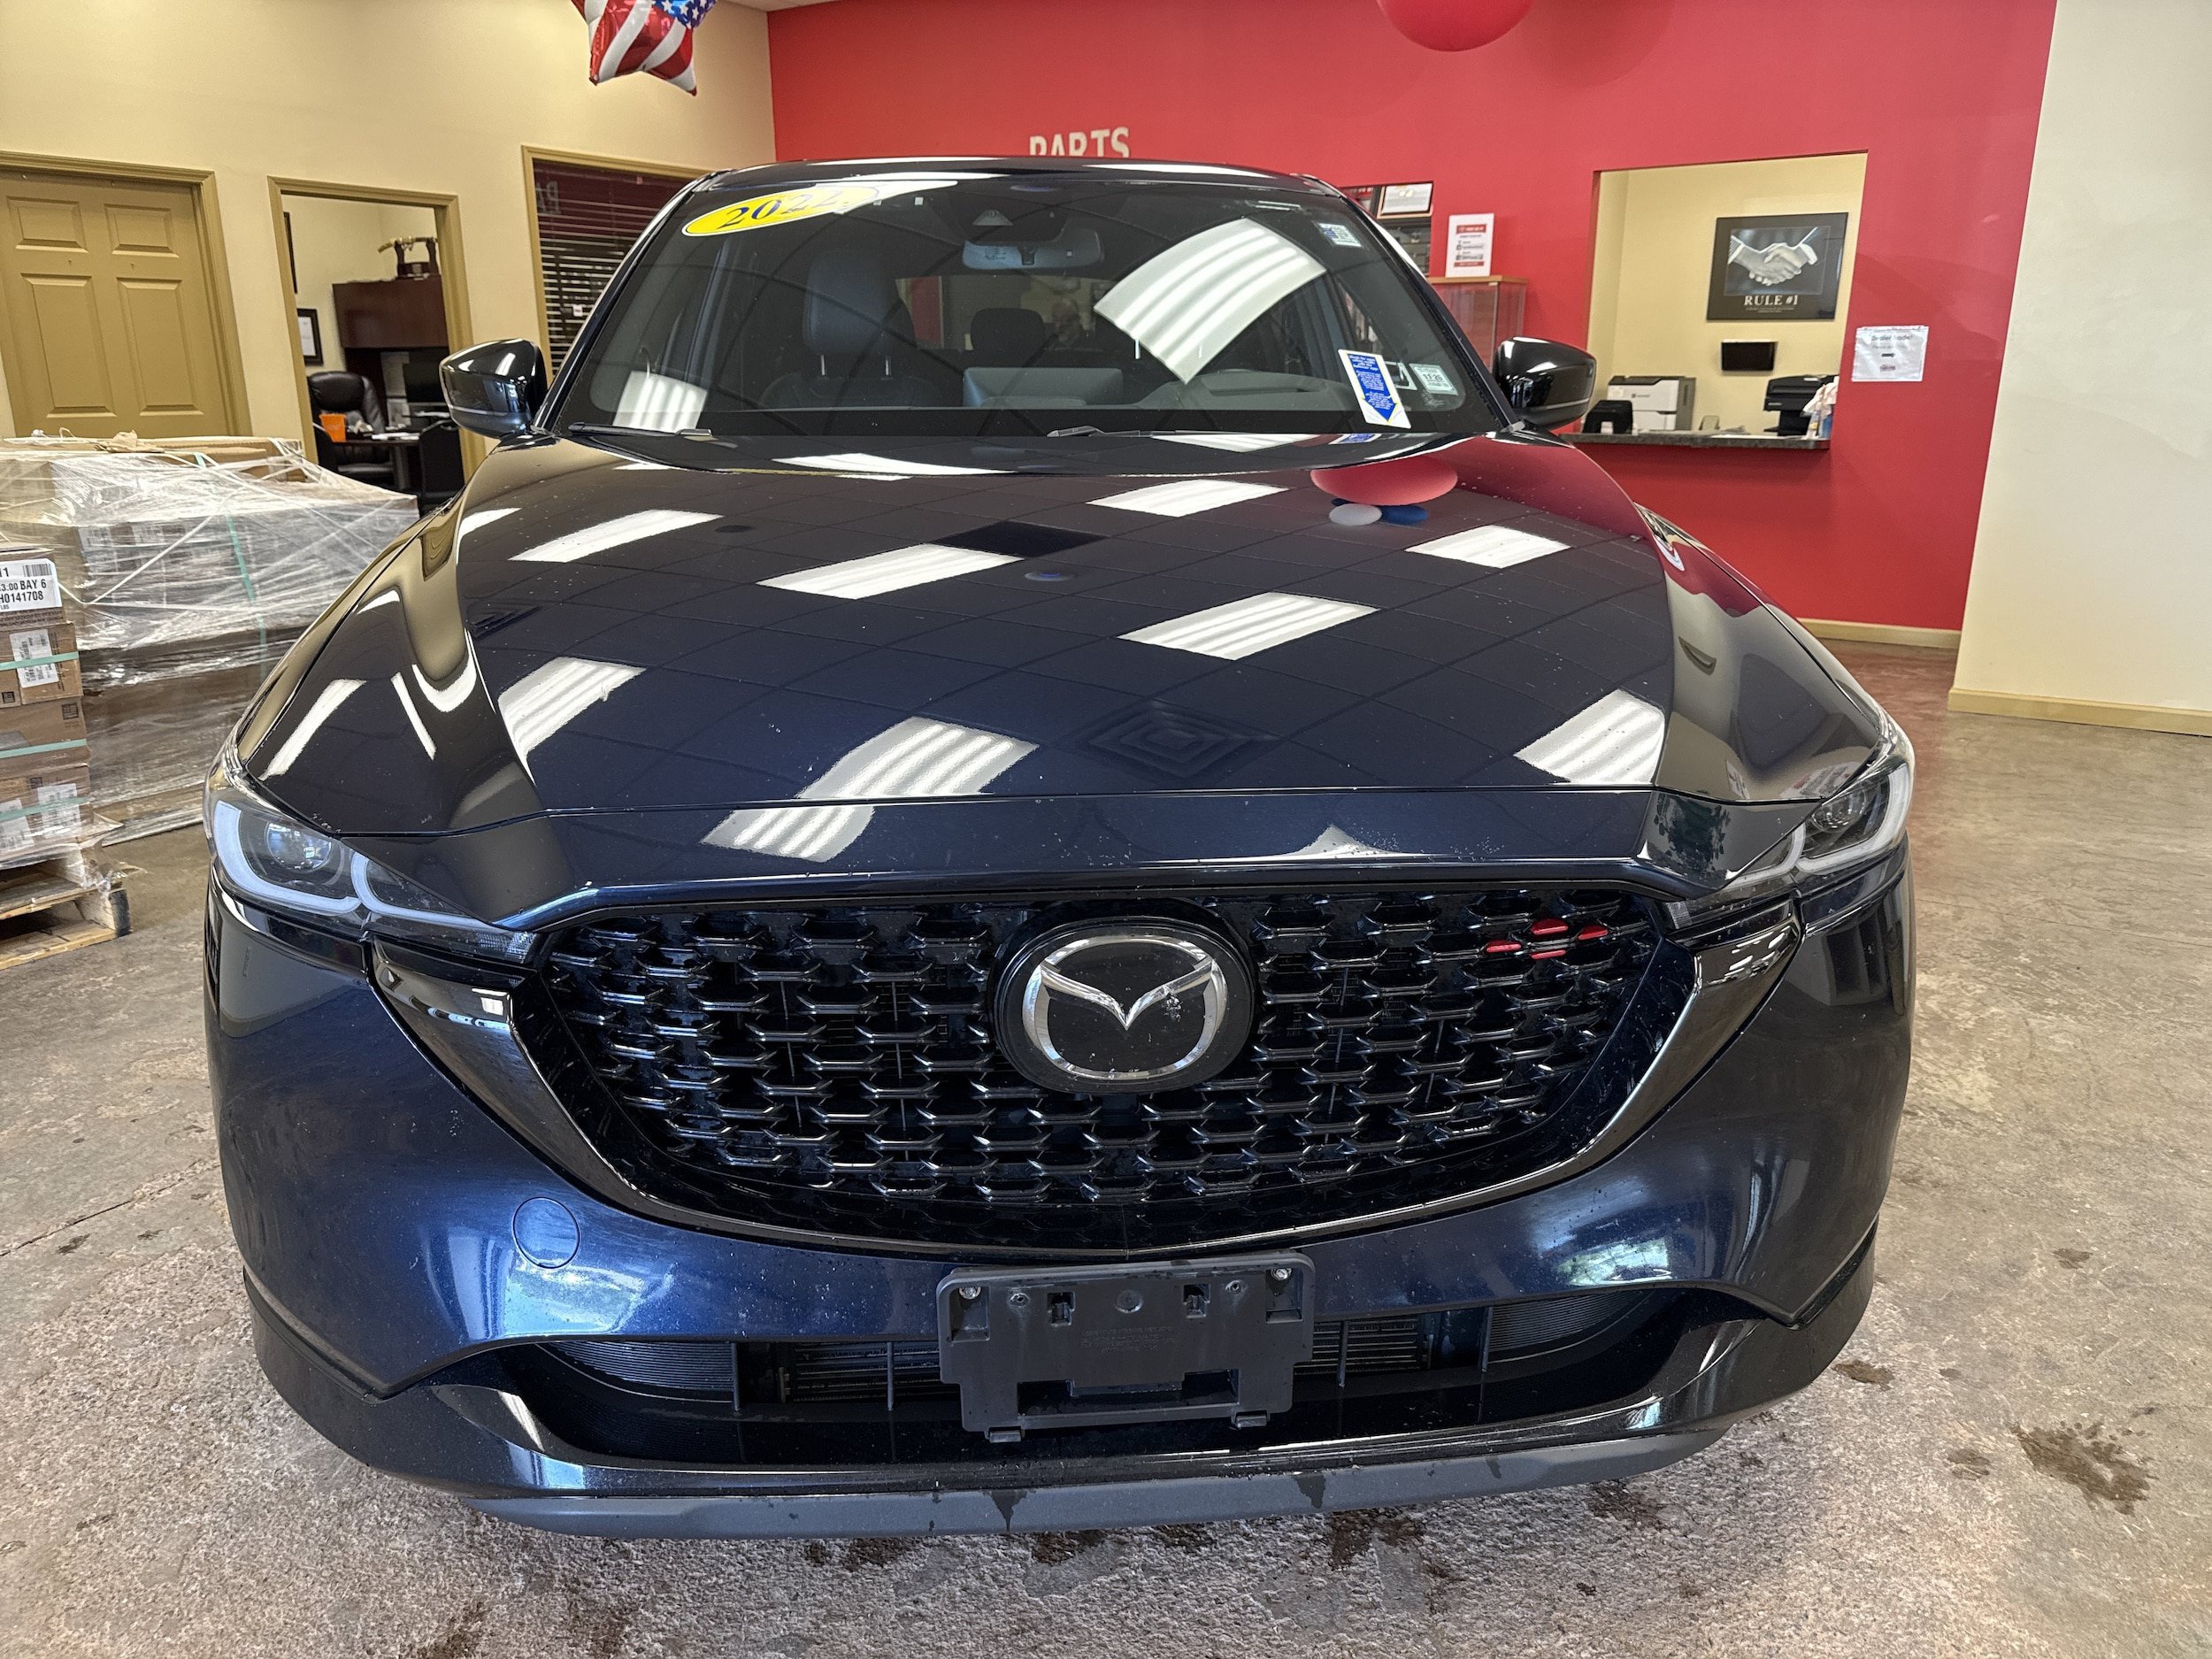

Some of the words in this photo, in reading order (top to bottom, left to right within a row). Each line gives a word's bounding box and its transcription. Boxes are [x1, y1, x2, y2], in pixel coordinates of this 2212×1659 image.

[1029, 127, 1131, 158] PARTS
[1743, 295, 1783, 306] RULE
[1786, 294, 1799, 306] #1
[19, 579, 37, 590] BAY
[41, 578, 47, 589] 6
